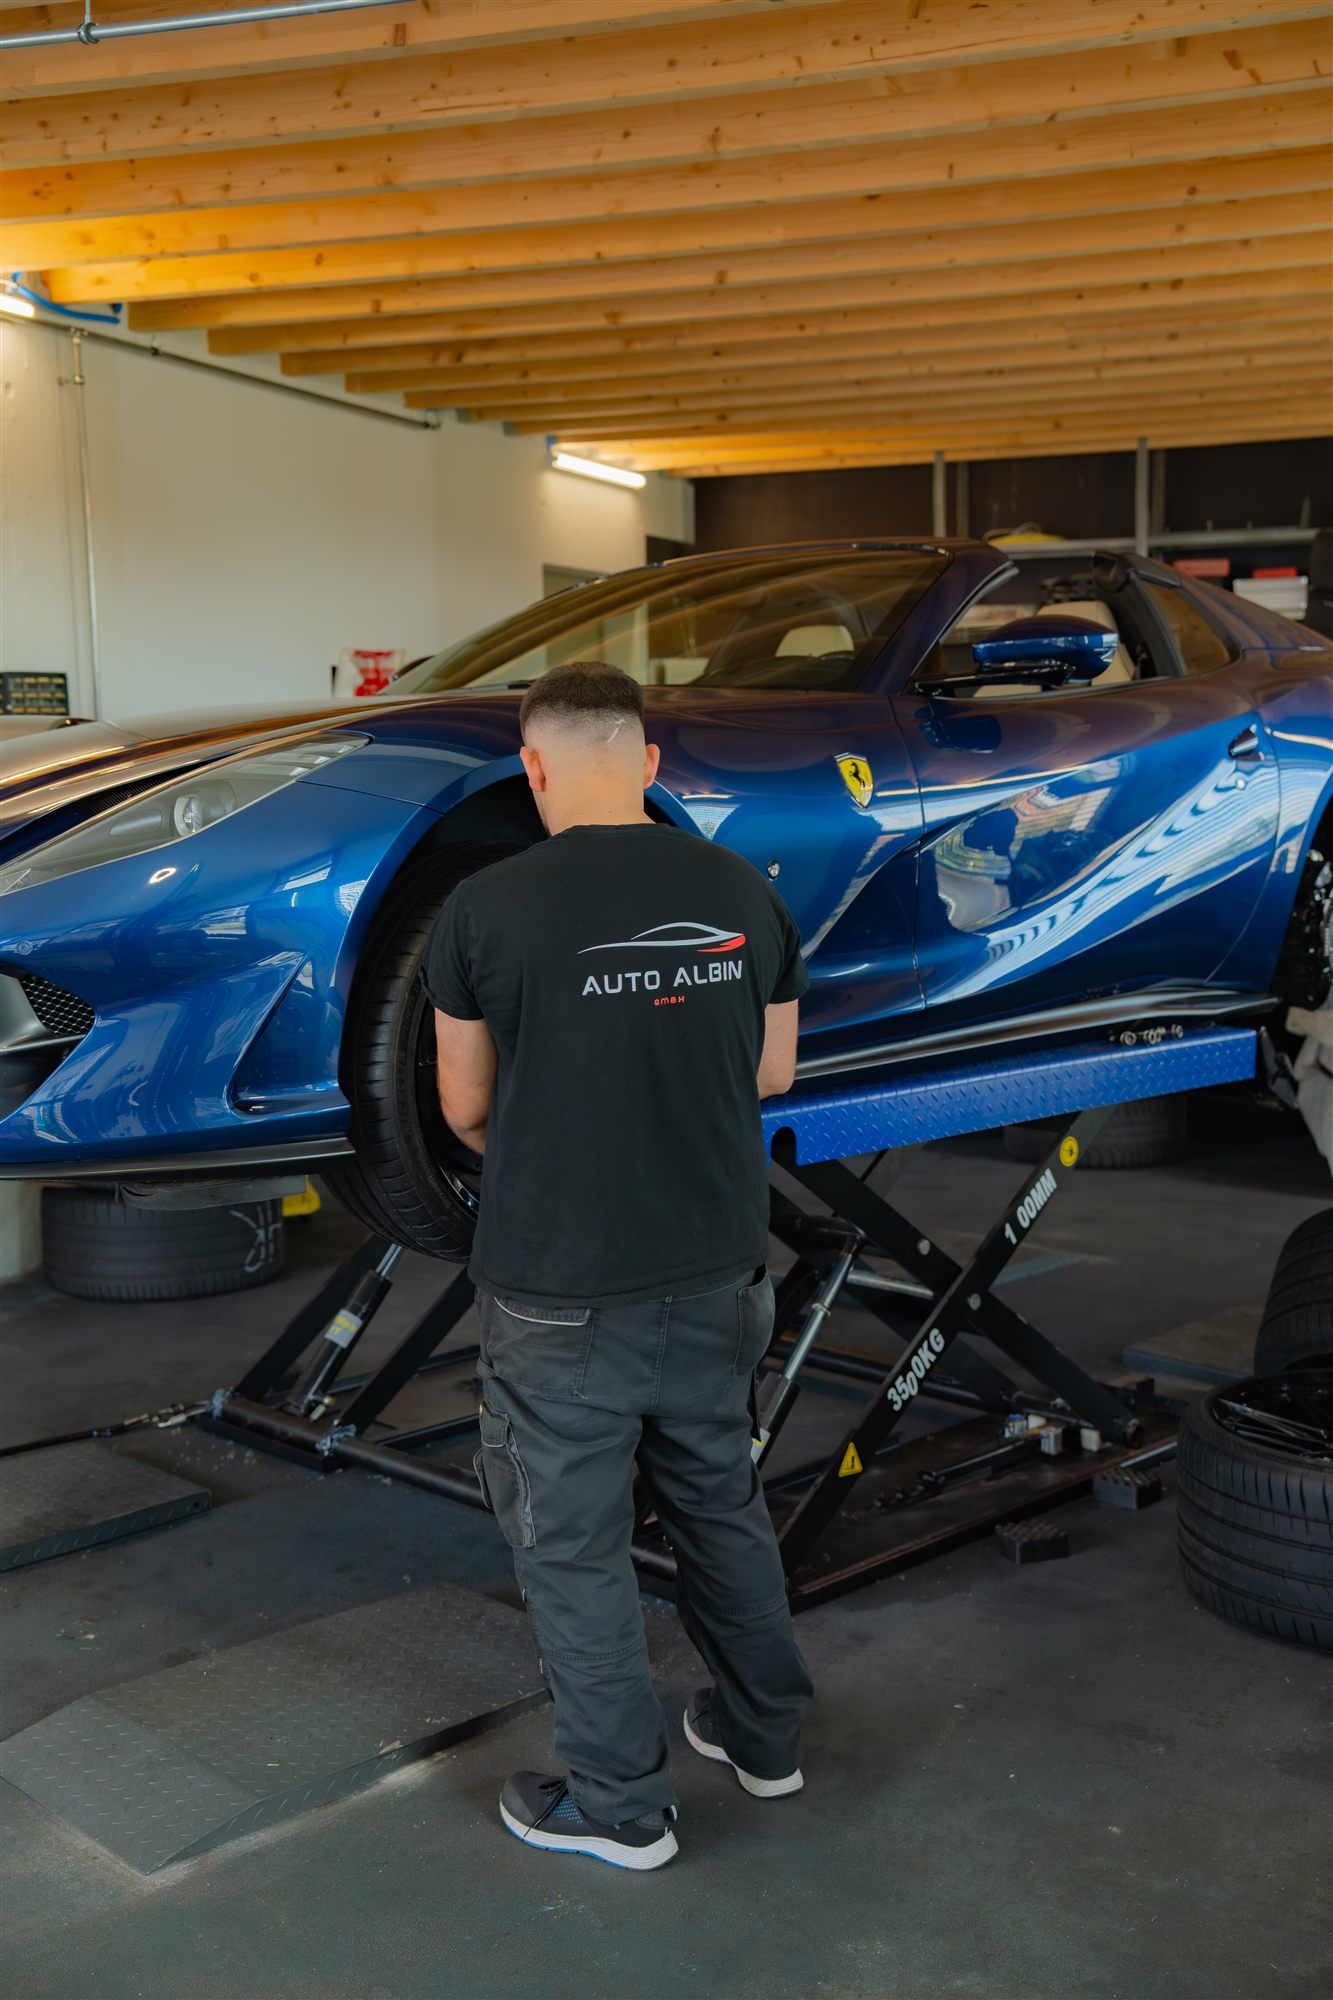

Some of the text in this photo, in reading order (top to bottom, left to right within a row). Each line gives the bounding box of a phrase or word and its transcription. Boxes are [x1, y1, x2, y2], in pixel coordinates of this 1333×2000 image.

[582, 960, 743, 996] AUTO ALBIN
[887, 1328, 945, 1411] 3500KG
